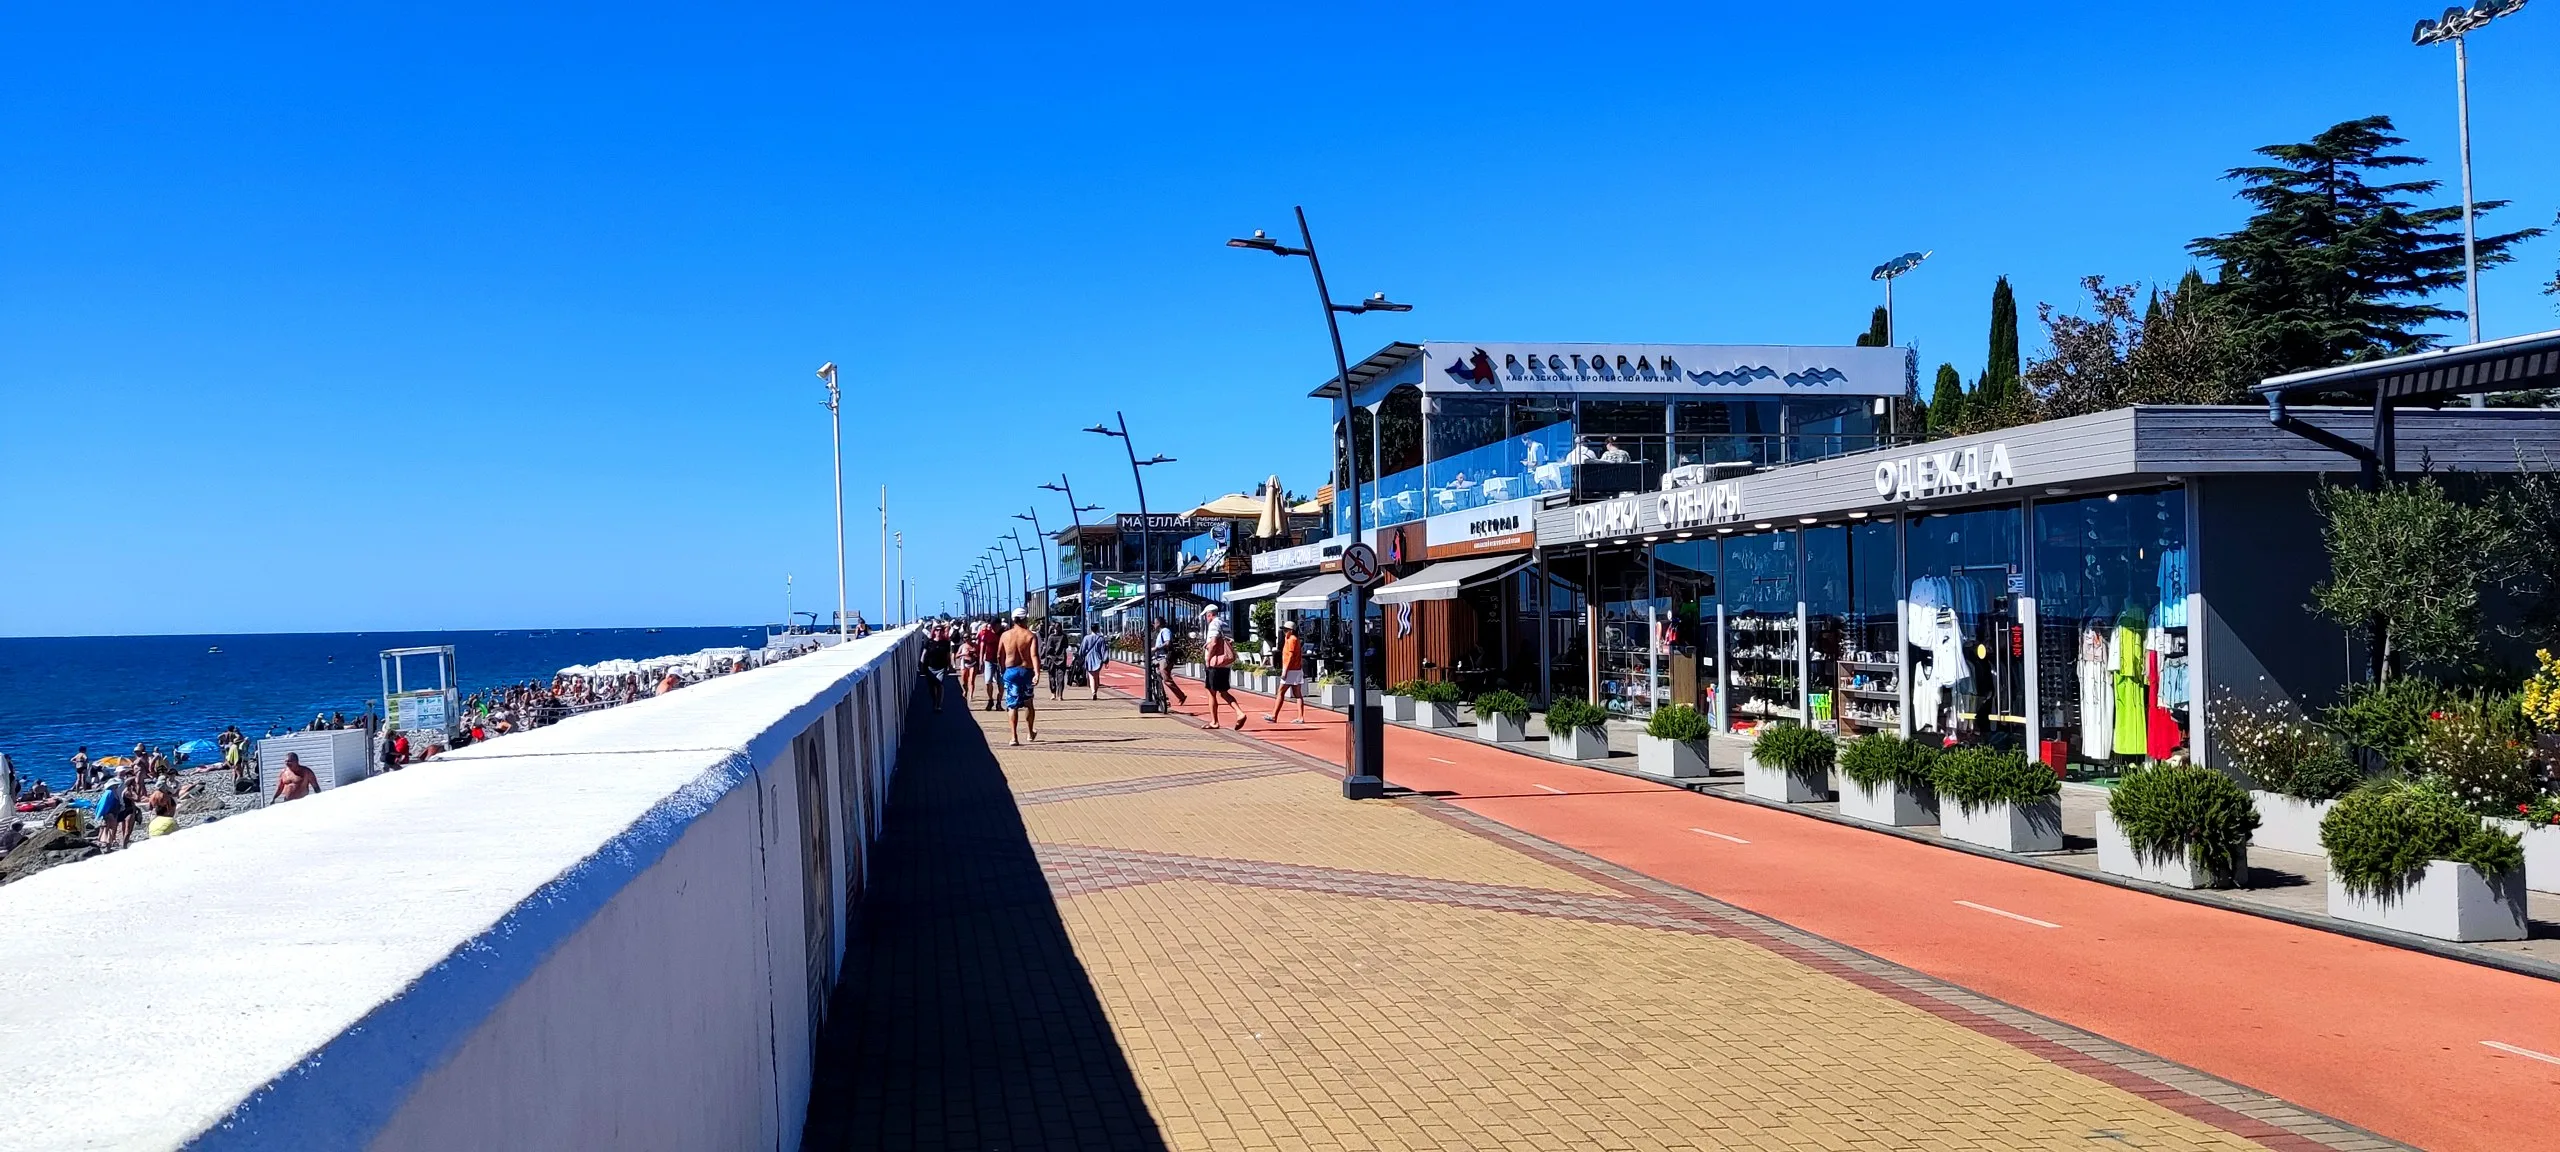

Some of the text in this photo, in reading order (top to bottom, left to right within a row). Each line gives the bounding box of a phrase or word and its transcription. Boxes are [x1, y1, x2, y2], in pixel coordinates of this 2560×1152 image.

[1505, 354, 1673, 371] РЕСТОРАН
[1575, 374, 1640, 382] ЕВРОПЕЙСКОЙ
[1643, 375, 1674, 383] КУХНИ
[1875, 443, 2014, 500] ОДЕЖДА
[1574, 481, 1742, 538] ПОДАРКИ СУВЕНИРЫ
[1122, 516, 1191, 528] МАЕЛЛАН
